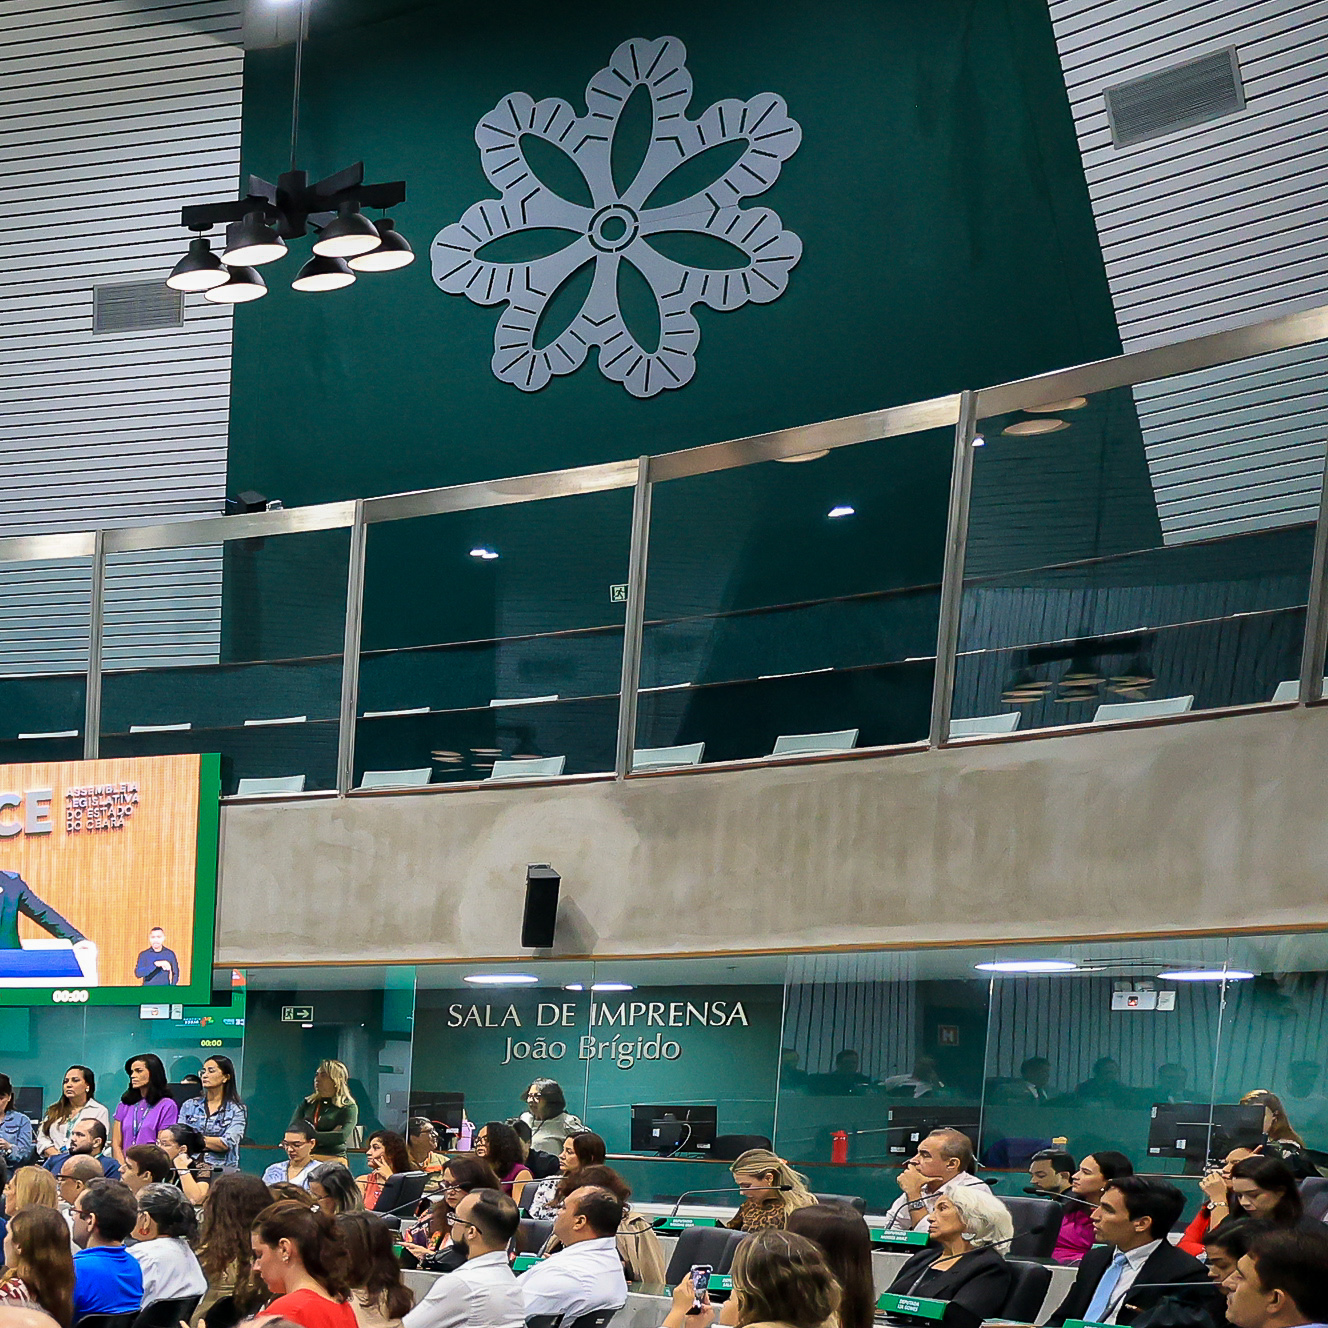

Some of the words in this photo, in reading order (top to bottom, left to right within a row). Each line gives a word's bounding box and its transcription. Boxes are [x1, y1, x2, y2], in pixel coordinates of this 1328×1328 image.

[66, 782, 139, 798] ASSEMBLEIA
[66, 793, 139, 809] LEGISLATIVA
[66, 810, 83, 820] DO
[87, 804, 133, 818] ESTADO
[66, 821, 82, 831] DO
[52, 989, 90, 1003] 00:00
[447, 1003, 522, 1027] SALA
[536, 1003, 576, 1027] DE
[592, 1001, 749, 1027] IMPRENSA
[501, 1036, 567, 1065] João
[578, 1033, 682, 1070] Brígido
